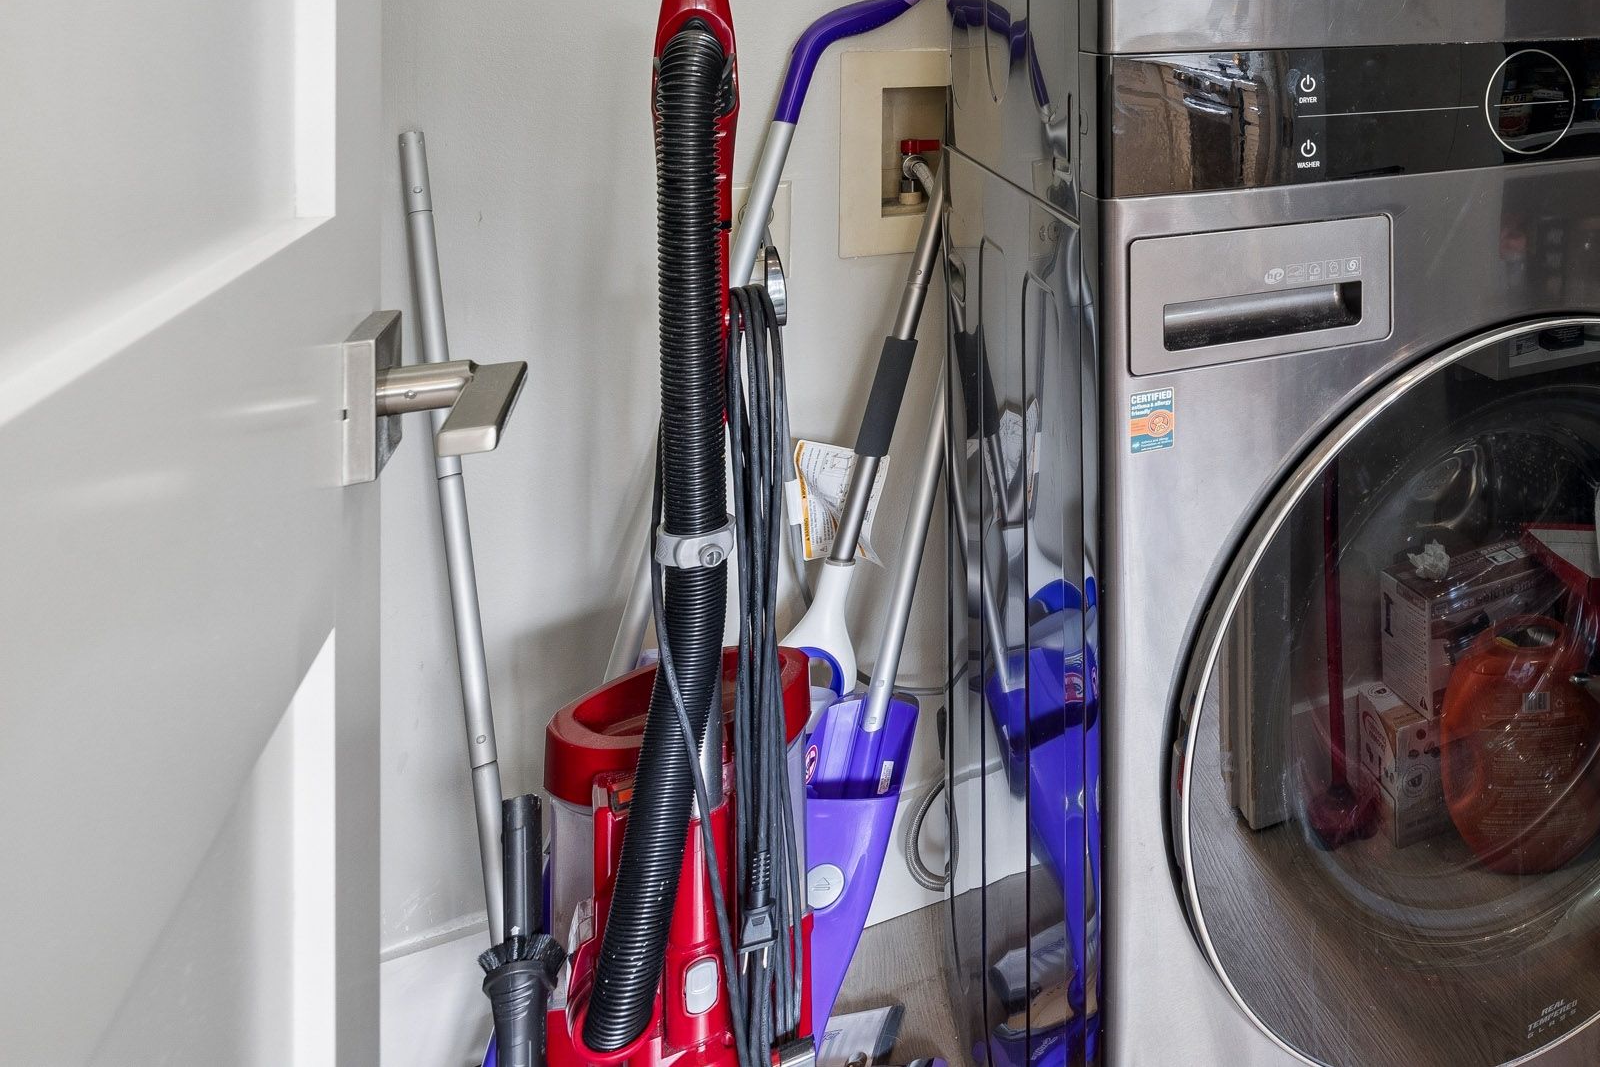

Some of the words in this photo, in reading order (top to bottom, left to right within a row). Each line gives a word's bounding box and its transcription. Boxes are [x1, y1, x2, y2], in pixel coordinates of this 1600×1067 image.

[1298, 96, 1317, 104] DRYER
[1296, 160, 1320, 169] WASHER
[1131, 390, 1172, 405] CERTIFIED
[1541, 999, 1565, 1016] REAL
[1527, 999, 1578, 1032] TEMPERED
